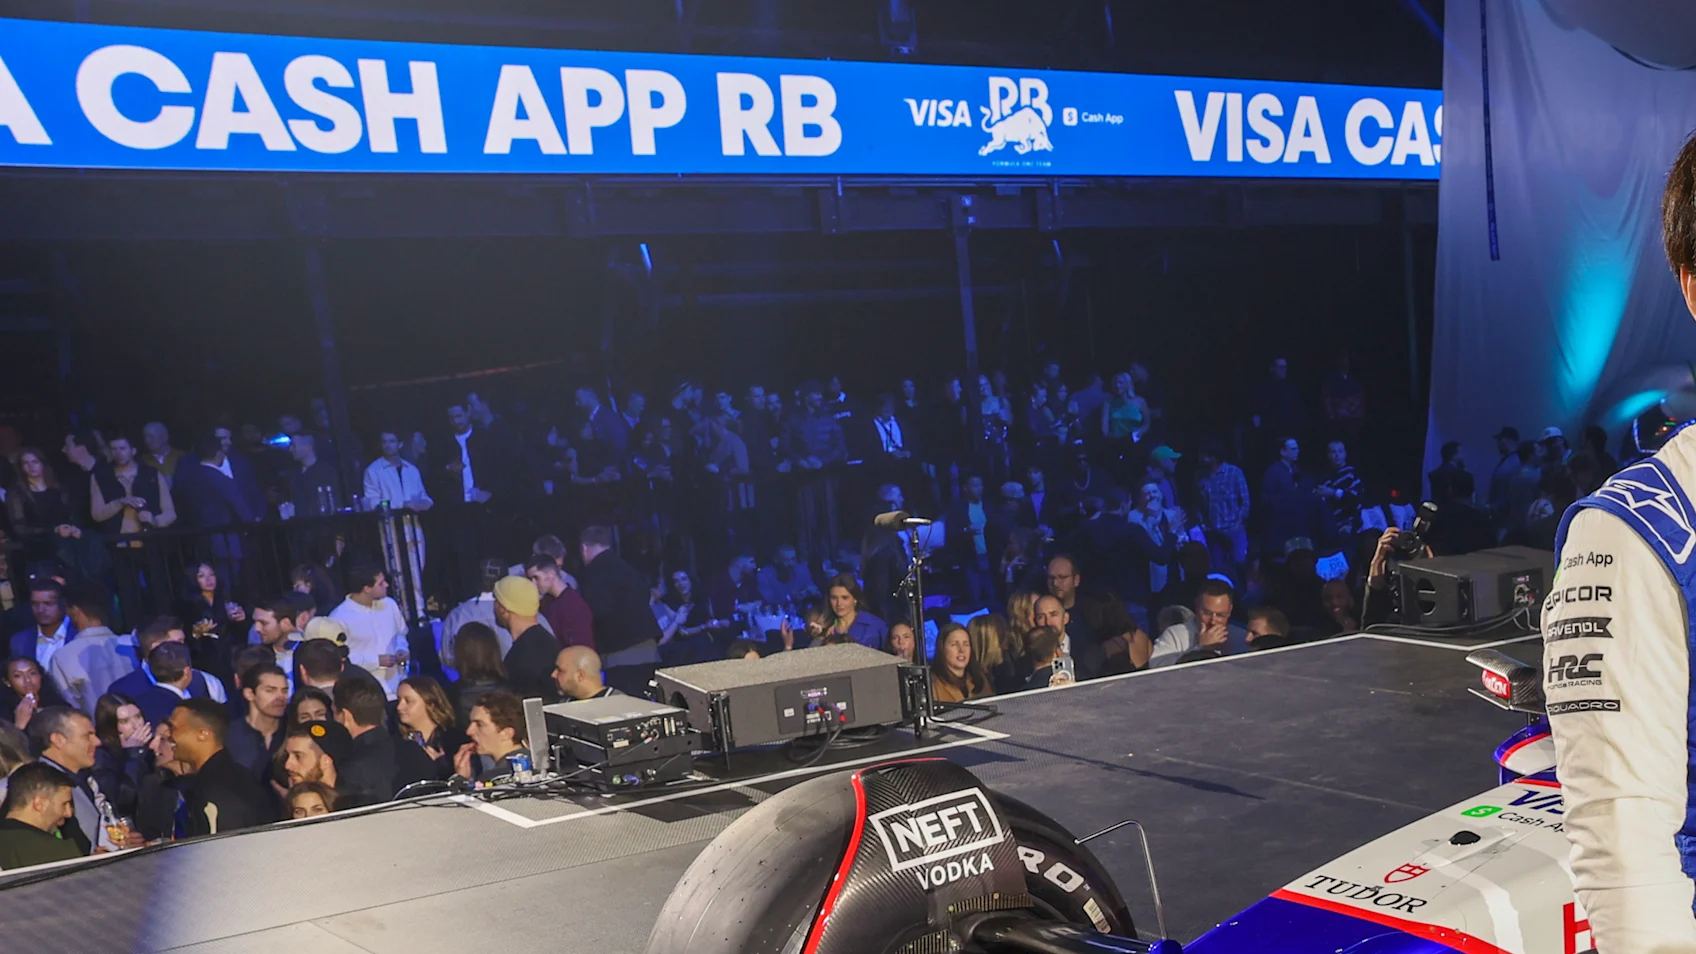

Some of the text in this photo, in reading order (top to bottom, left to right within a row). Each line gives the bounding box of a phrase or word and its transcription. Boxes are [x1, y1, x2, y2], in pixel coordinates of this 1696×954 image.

[75, 44, 448, 154] CASH
[484, 64, 687, 156] APP
[716, 72, 843, 157] RB
[903, 98, 972, 128] VISA
[1081, 112, 1124, 125] Cash App
[1174, 90, 1443, 166] VISA CA
[1563, 551, 1614, 570] Cash App
[1548, 653, 1604, 683] HRC
[1568, 679, 1603, 688] RACING
[890, 801, 979, 853] NEFT
[1498, 812, 1545, 827] Cash
[916, 853, 995, 891] VODKA
[1304, 875, 1428, 914] TUDOR
